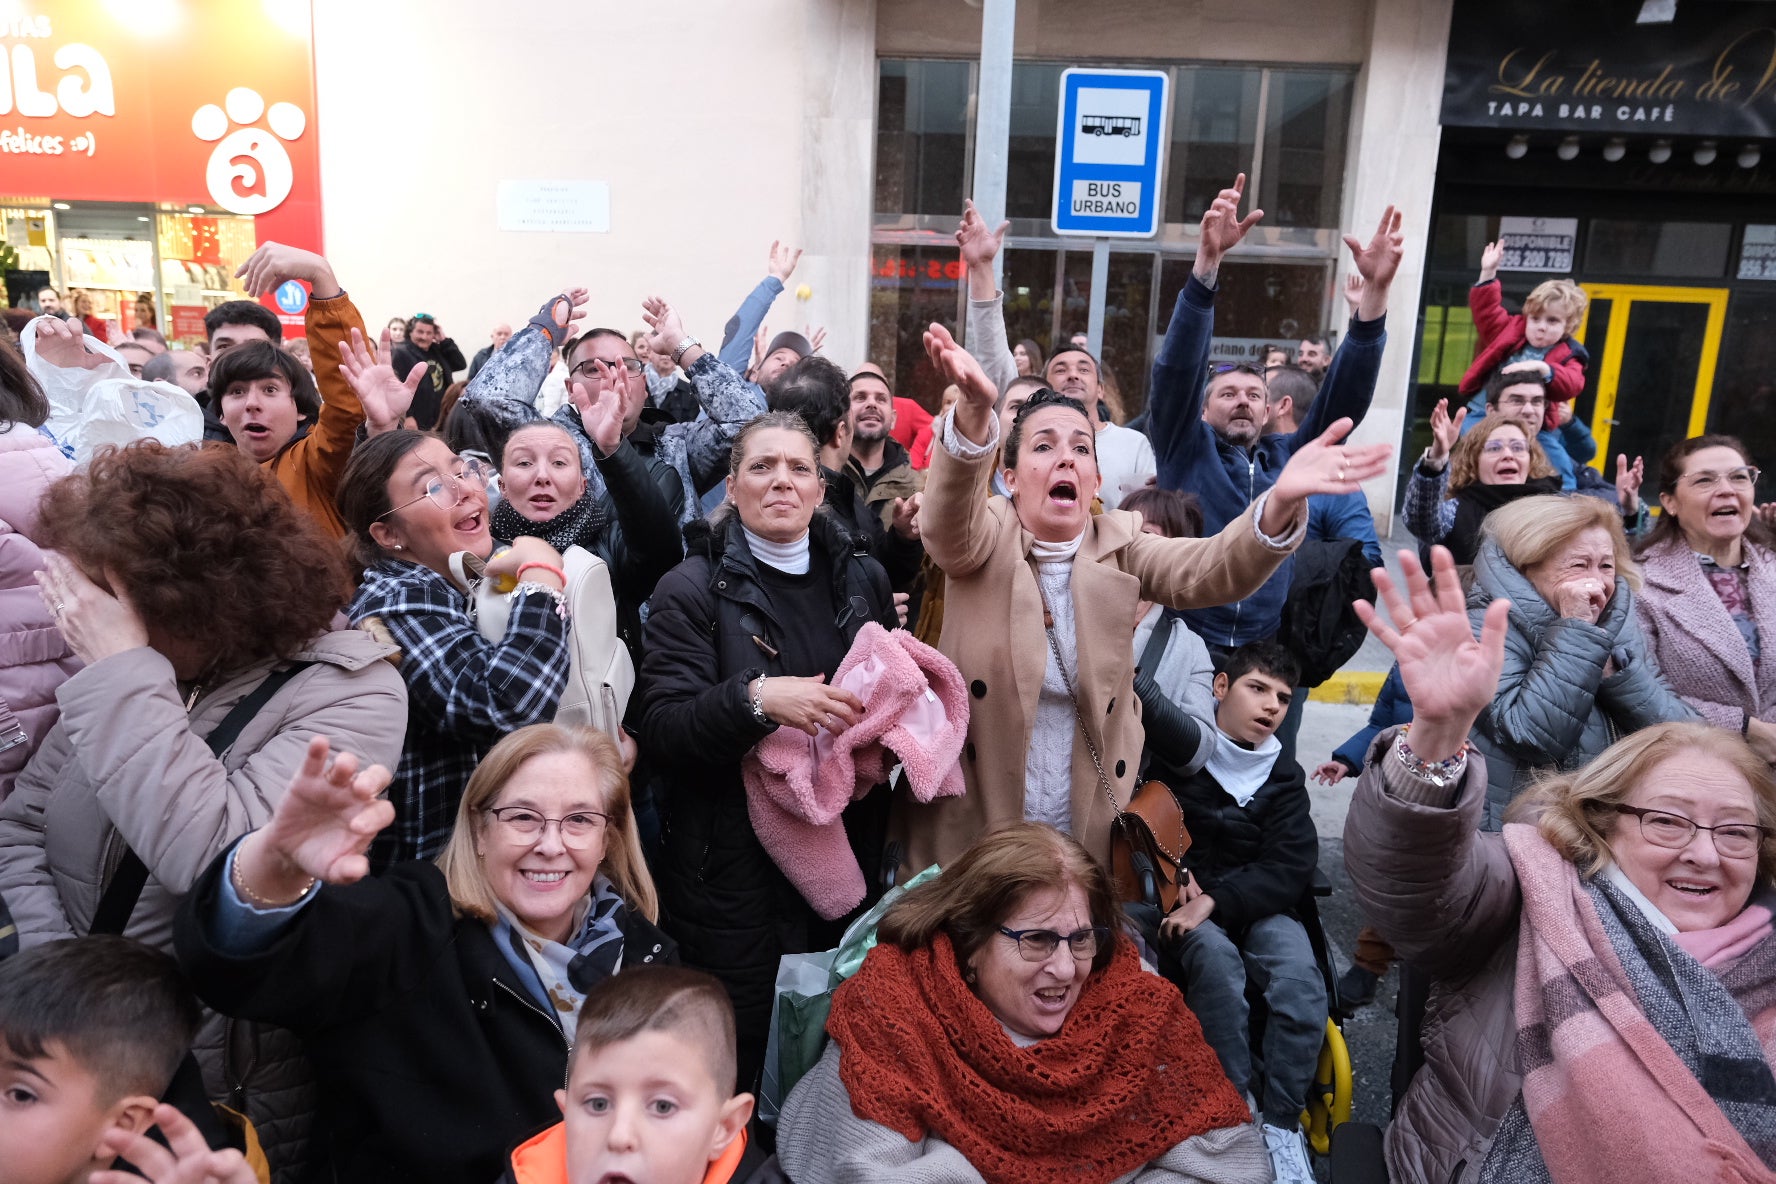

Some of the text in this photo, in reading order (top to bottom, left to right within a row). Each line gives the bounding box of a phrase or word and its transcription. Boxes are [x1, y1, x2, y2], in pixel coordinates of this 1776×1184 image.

[1573, 58, 1685, 99] tienda
[1694, 64, 1740, 102] de
[1488, 101, 1675, 121] TAPA BAR CAFÉ
[1088, 183, 1122, 198] BUS
[1073, 199, 1137, 215] URBANO
[1503, 235, 1571, 249] DISPONIBLE
